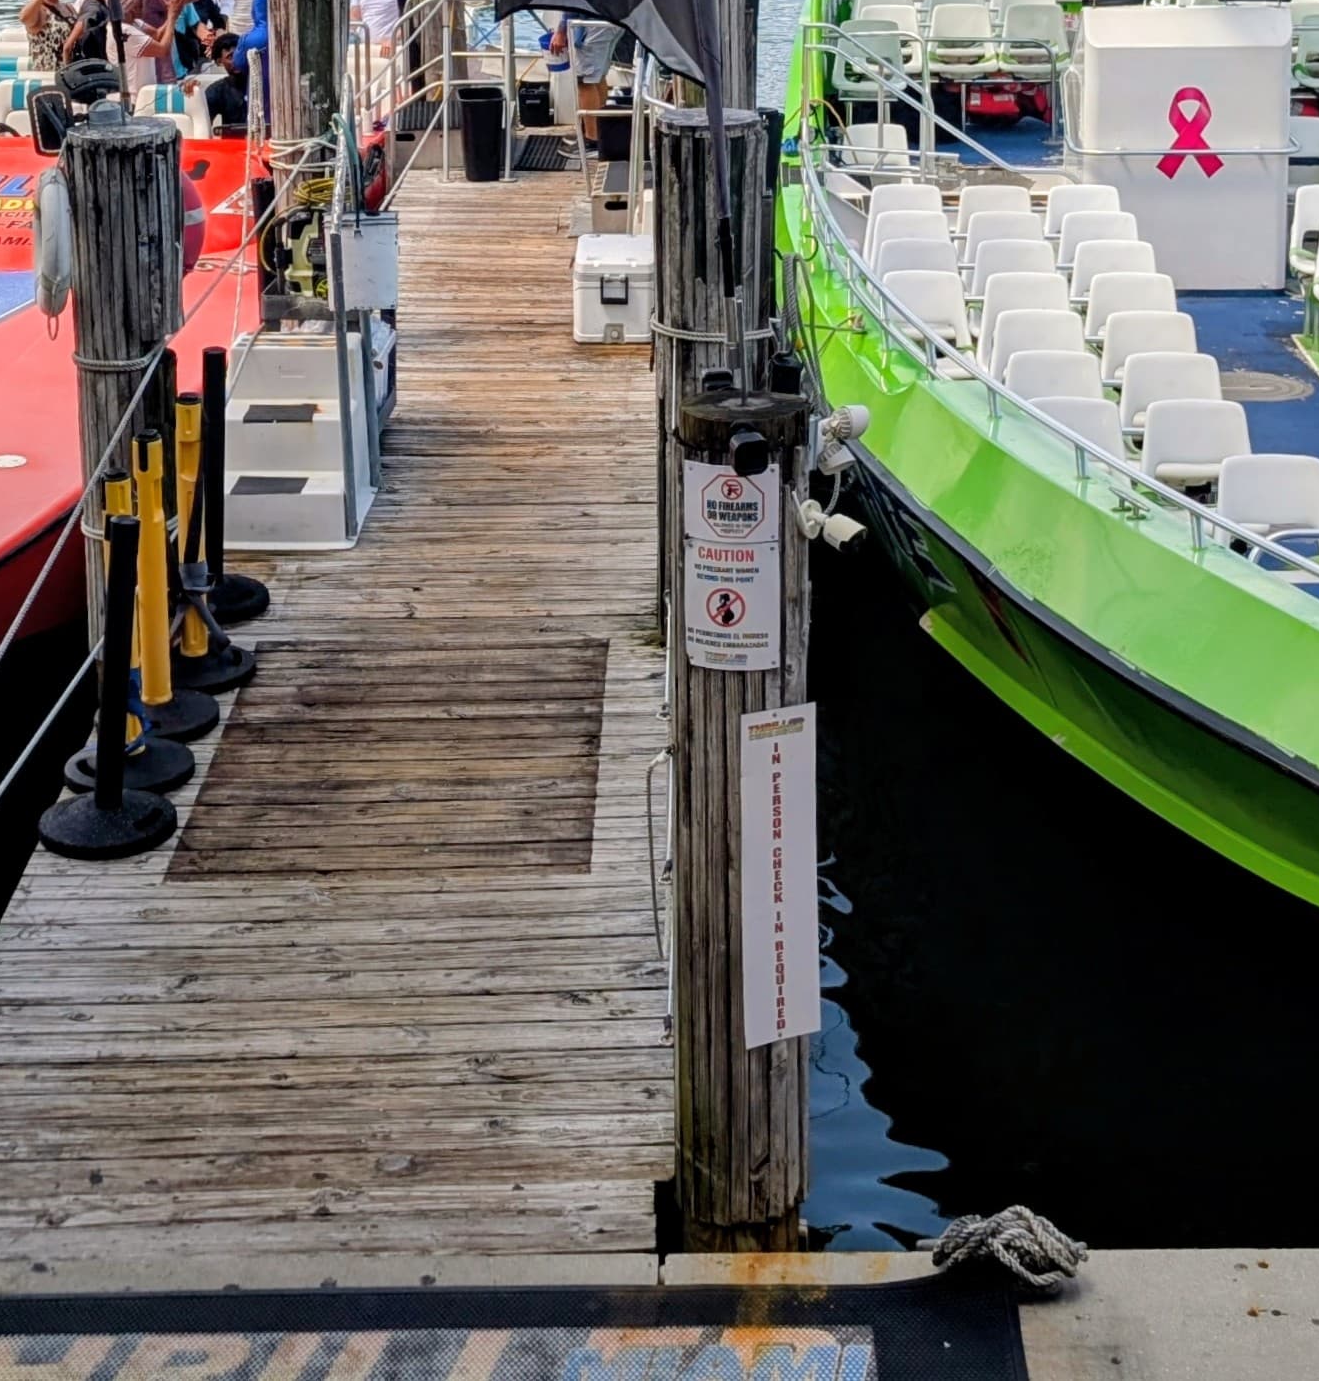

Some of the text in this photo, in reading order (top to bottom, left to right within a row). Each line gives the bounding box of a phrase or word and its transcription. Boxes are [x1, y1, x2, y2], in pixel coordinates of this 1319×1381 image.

[707, 500, 758, 511] NO FIREARMS
[707, 510, 758, 522] OR WEAPONS
[697, 546, 755, 562] CAUTION
[771, 742, 786, 1030] IN PERSON CHECK IN REQUIRED
